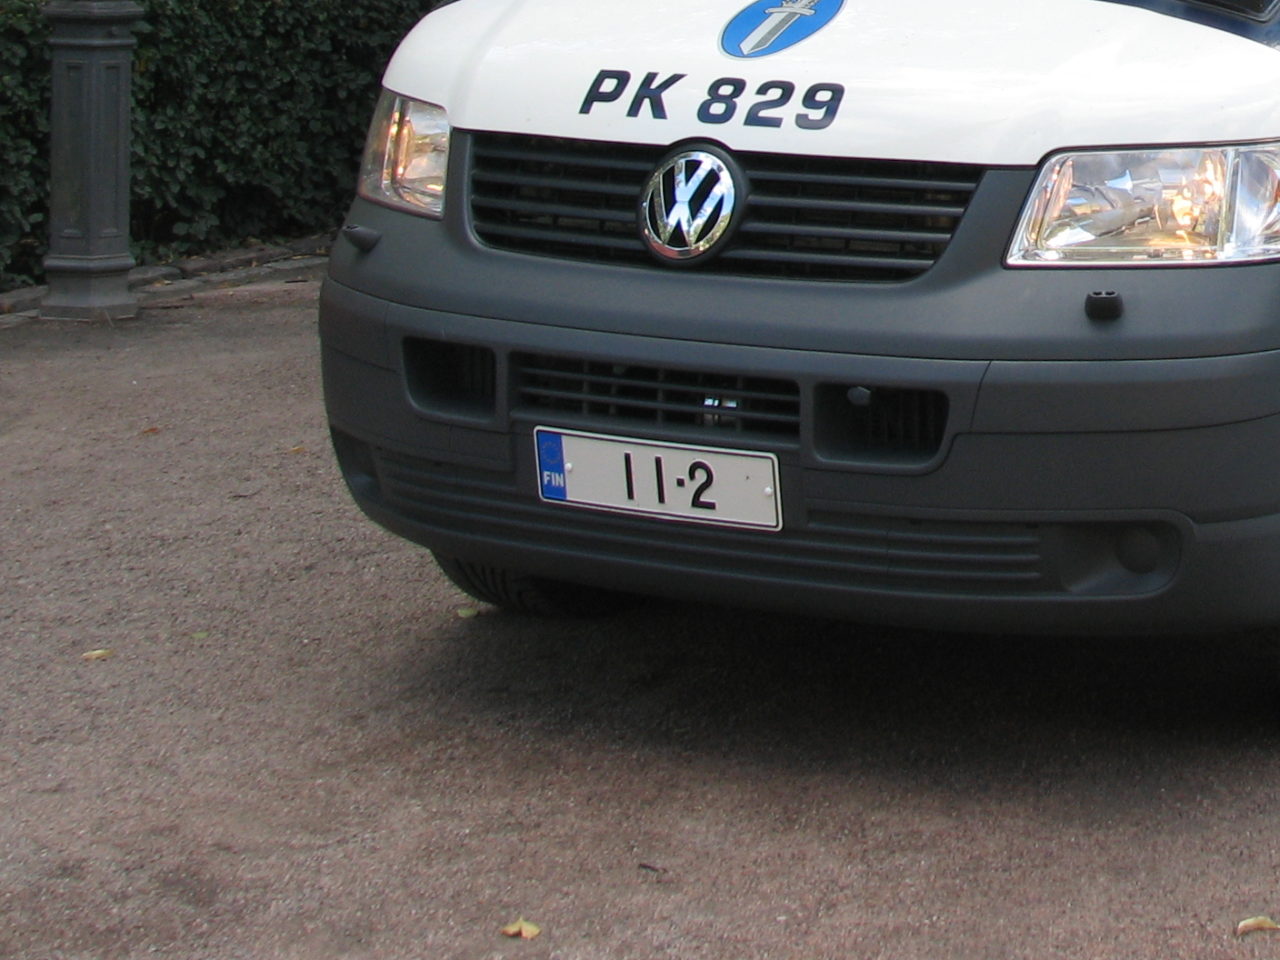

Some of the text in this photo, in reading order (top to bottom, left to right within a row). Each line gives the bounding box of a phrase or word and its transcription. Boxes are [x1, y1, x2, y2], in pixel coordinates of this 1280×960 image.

[579, 69, 845, 130] PK 829
[543, 471, 565, 487] FIN
